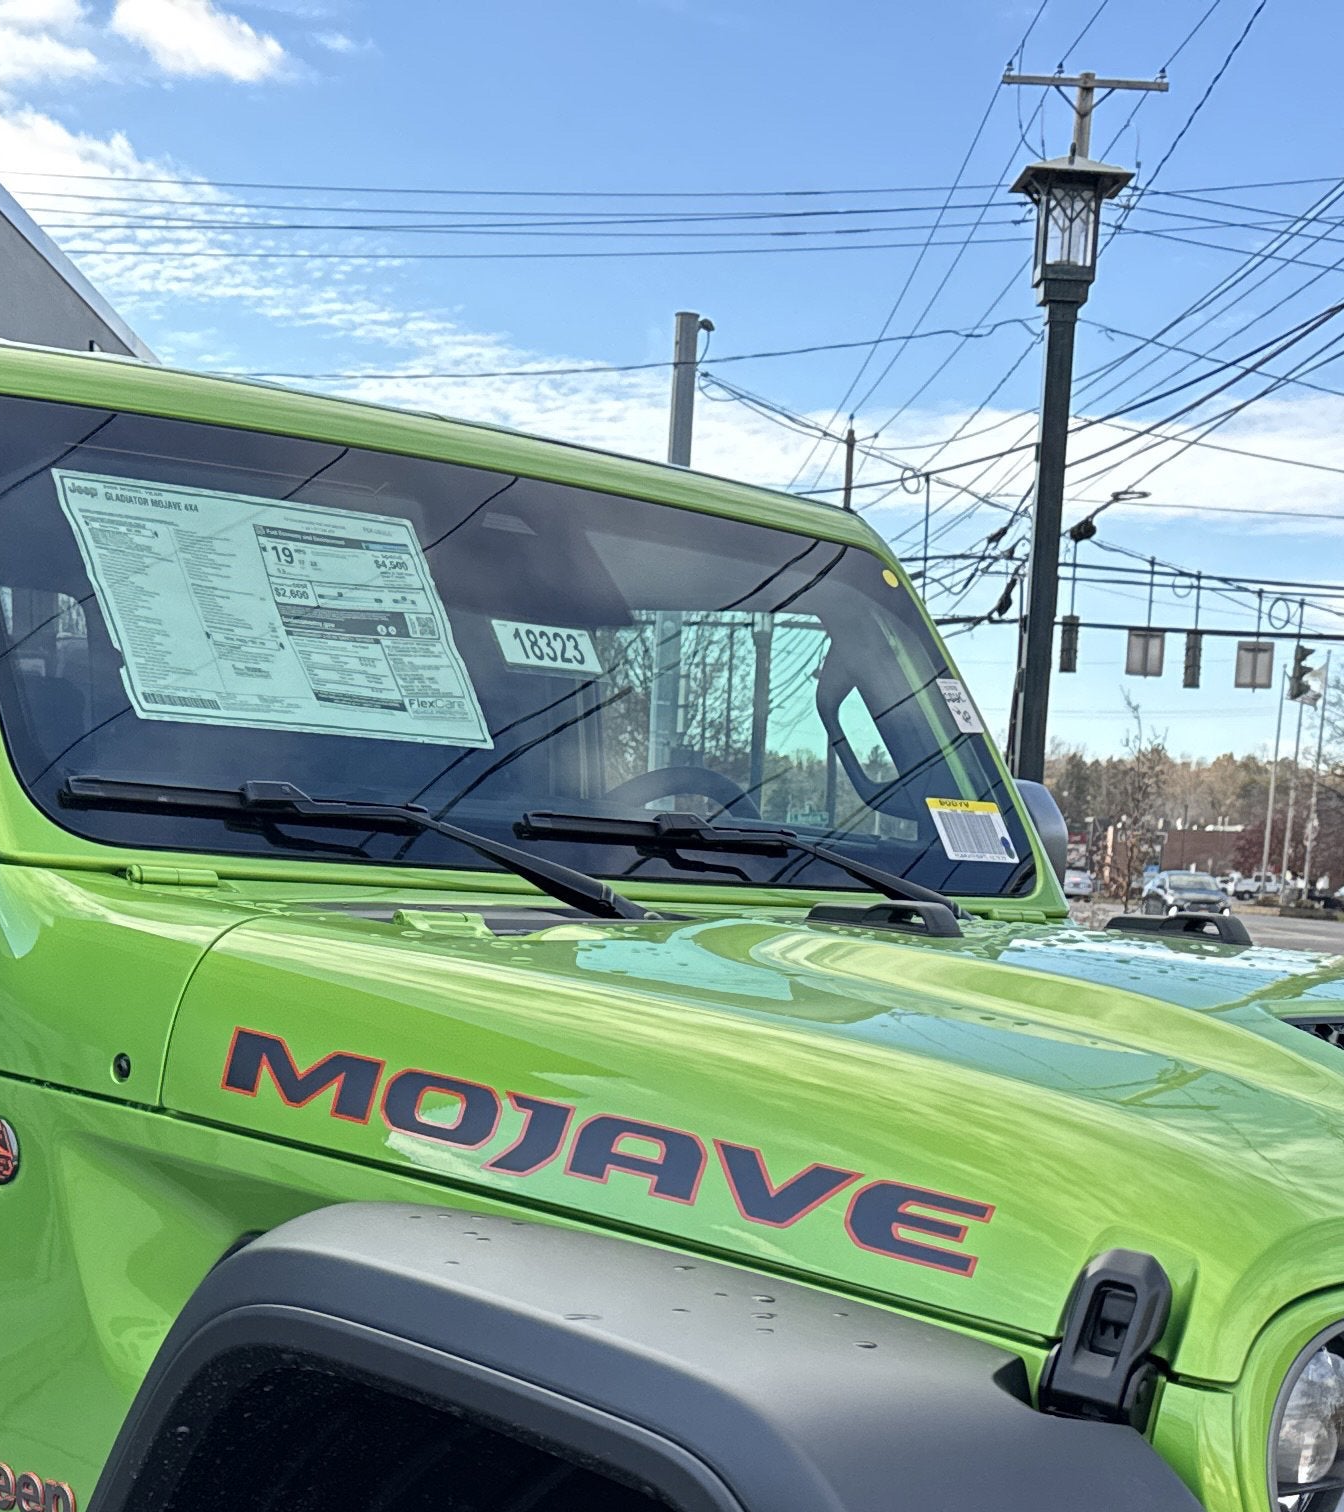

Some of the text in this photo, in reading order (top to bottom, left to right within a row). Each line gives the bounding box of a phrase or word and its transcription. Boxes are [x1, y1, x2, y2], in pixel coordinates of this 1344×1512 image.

[104, 492, 149, 507] GLADIATOR
[150, 498, 182, 511] MOJAVE
[271, 545, 295, 565] 19
[513, 627, 585, 665] 18323
[408, 697, 465, 710] FlexCare
[220, 1026, 996, 1278] MOJAVE
